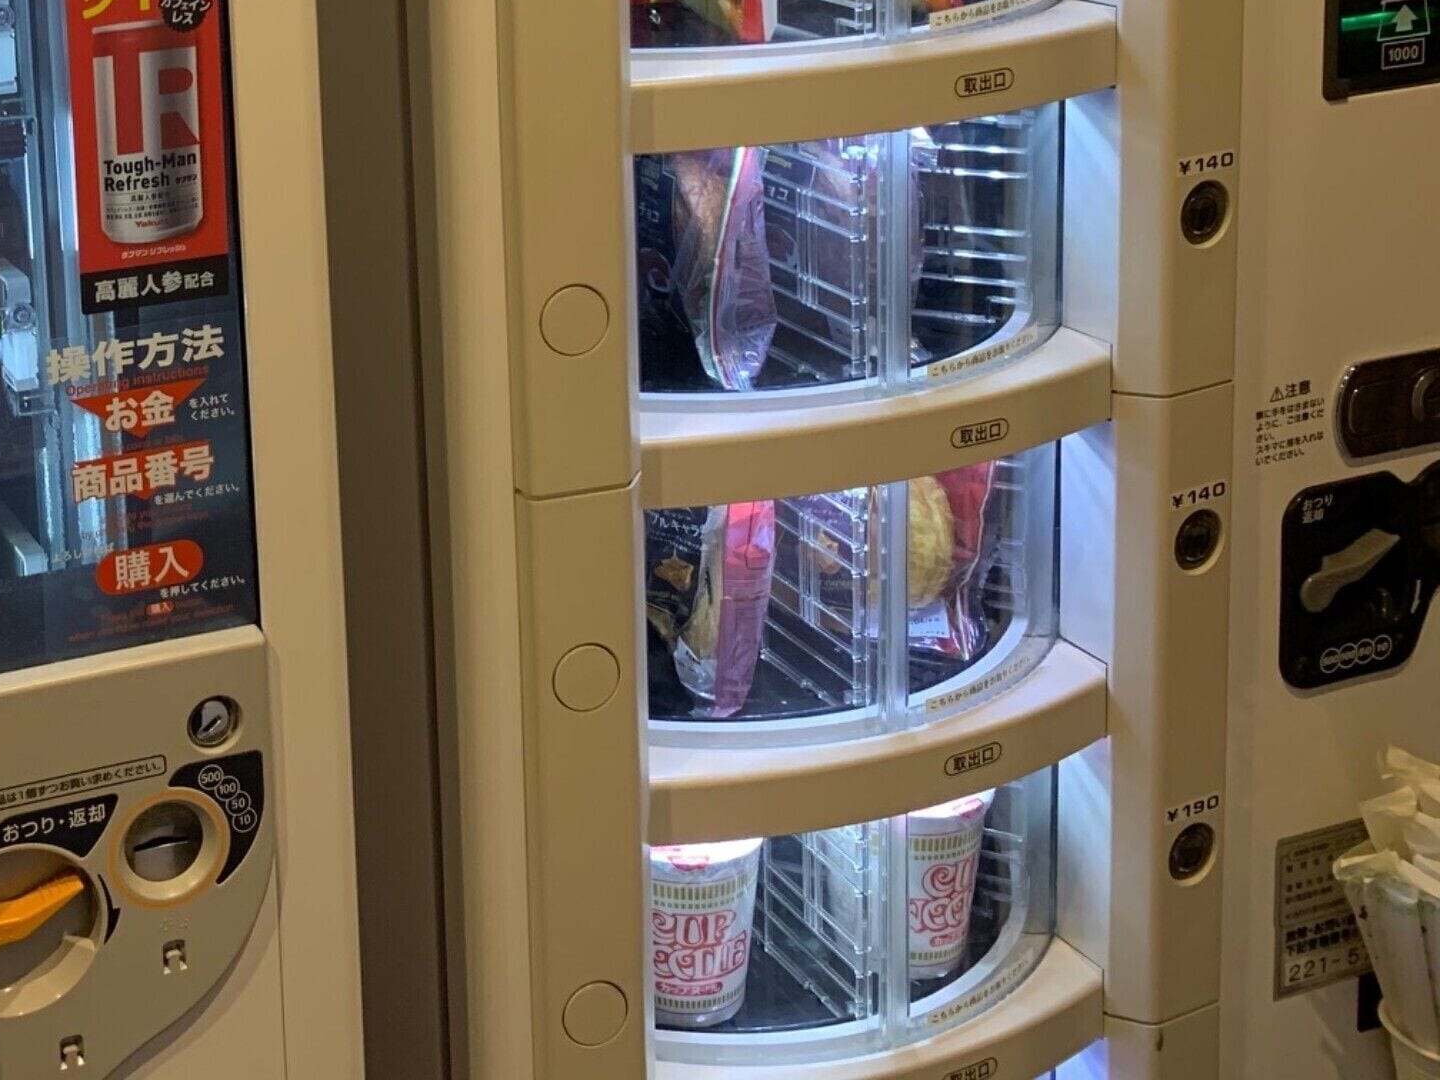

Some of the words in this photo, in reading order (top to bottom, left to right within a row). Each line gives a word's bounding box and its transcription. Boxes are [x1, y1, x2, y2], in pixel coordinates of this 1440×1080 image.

[171, 11, 194, 25] レス
[1387, 45, 1419, 63] 1000
[962, 72, 1009, 95] 取出口
[103, 151, 197, 176] Tough-Man
[1178, 152, 1234, 175] ¥140
[104, 173, 170, 193] Refresh
[94, 270, 215, 304] 高麗人参配合
[45, 323, 225, 386] 操作方法
[104, 389, 176, 432] お金
[188, 392, 229, 409] を入れて
[959, 422, 1002, 445] 取出口
[71, 444, 214, 504] 商品番号
[1172, 482, 1226, 508] ¥140
[114, 545, 190, 590] 購入
[952, 745, 995, 772] 取出口
[200, 771, 221, 783] 500
[218, 782, 237, 794] 100
[231, 797, 246, 809] 50
[1166, 794, 1220, 822] ¥190
[2, 803, 106, 843] おつり・返却
[239, 814, 251, 825] 10
